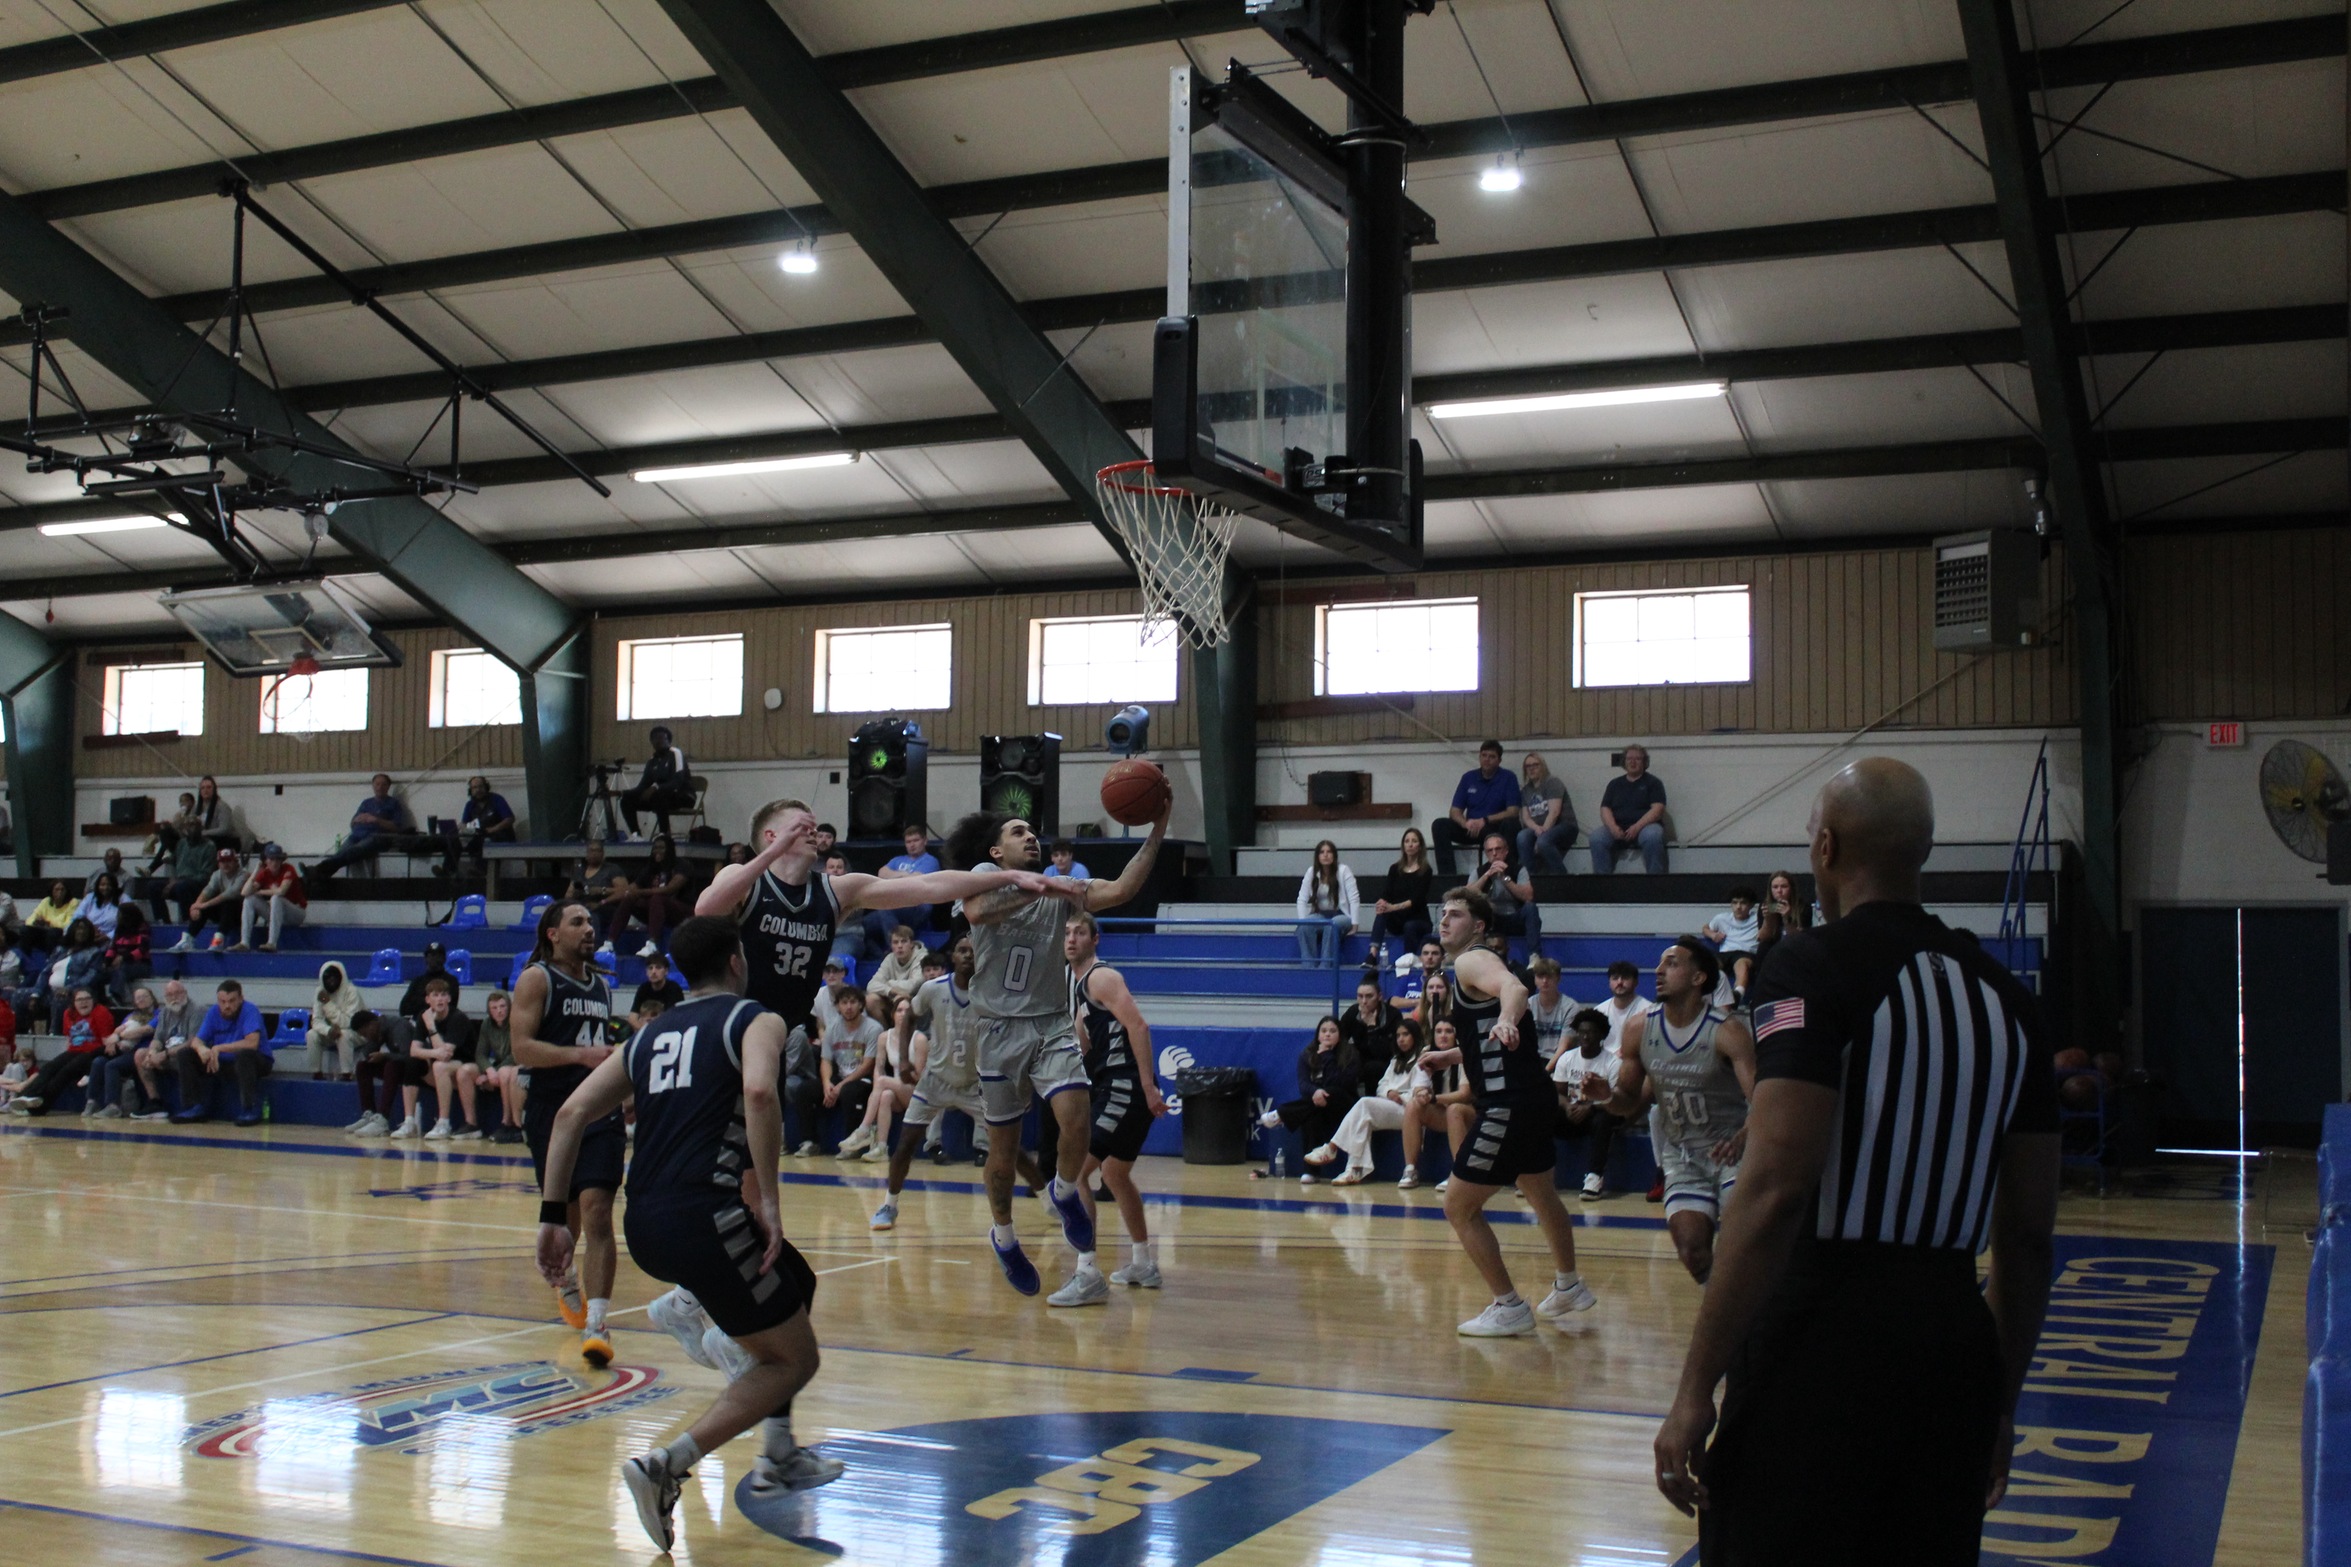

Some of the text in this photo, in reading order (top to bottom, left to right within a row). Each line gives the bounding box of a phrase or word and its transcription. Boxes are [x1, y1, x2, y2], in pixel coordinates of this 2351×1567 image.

[2210, 722, 2239, 745] EXIT
[759, 913, 828, 941] COLUMBIA
[773, 941, 813, 980] 32
[1003, 944, 1034, 993] 0
[562, 997, 609, 1020] COLUMBI
[575, 1020, 605, 1047] 44
[648, 1025, 698, 1094] 21
[952, 1039, 967, 1068] 2
[1663, 1091, 1709, 1126] 20
[963, 1437, 1262, 1536] CBC
